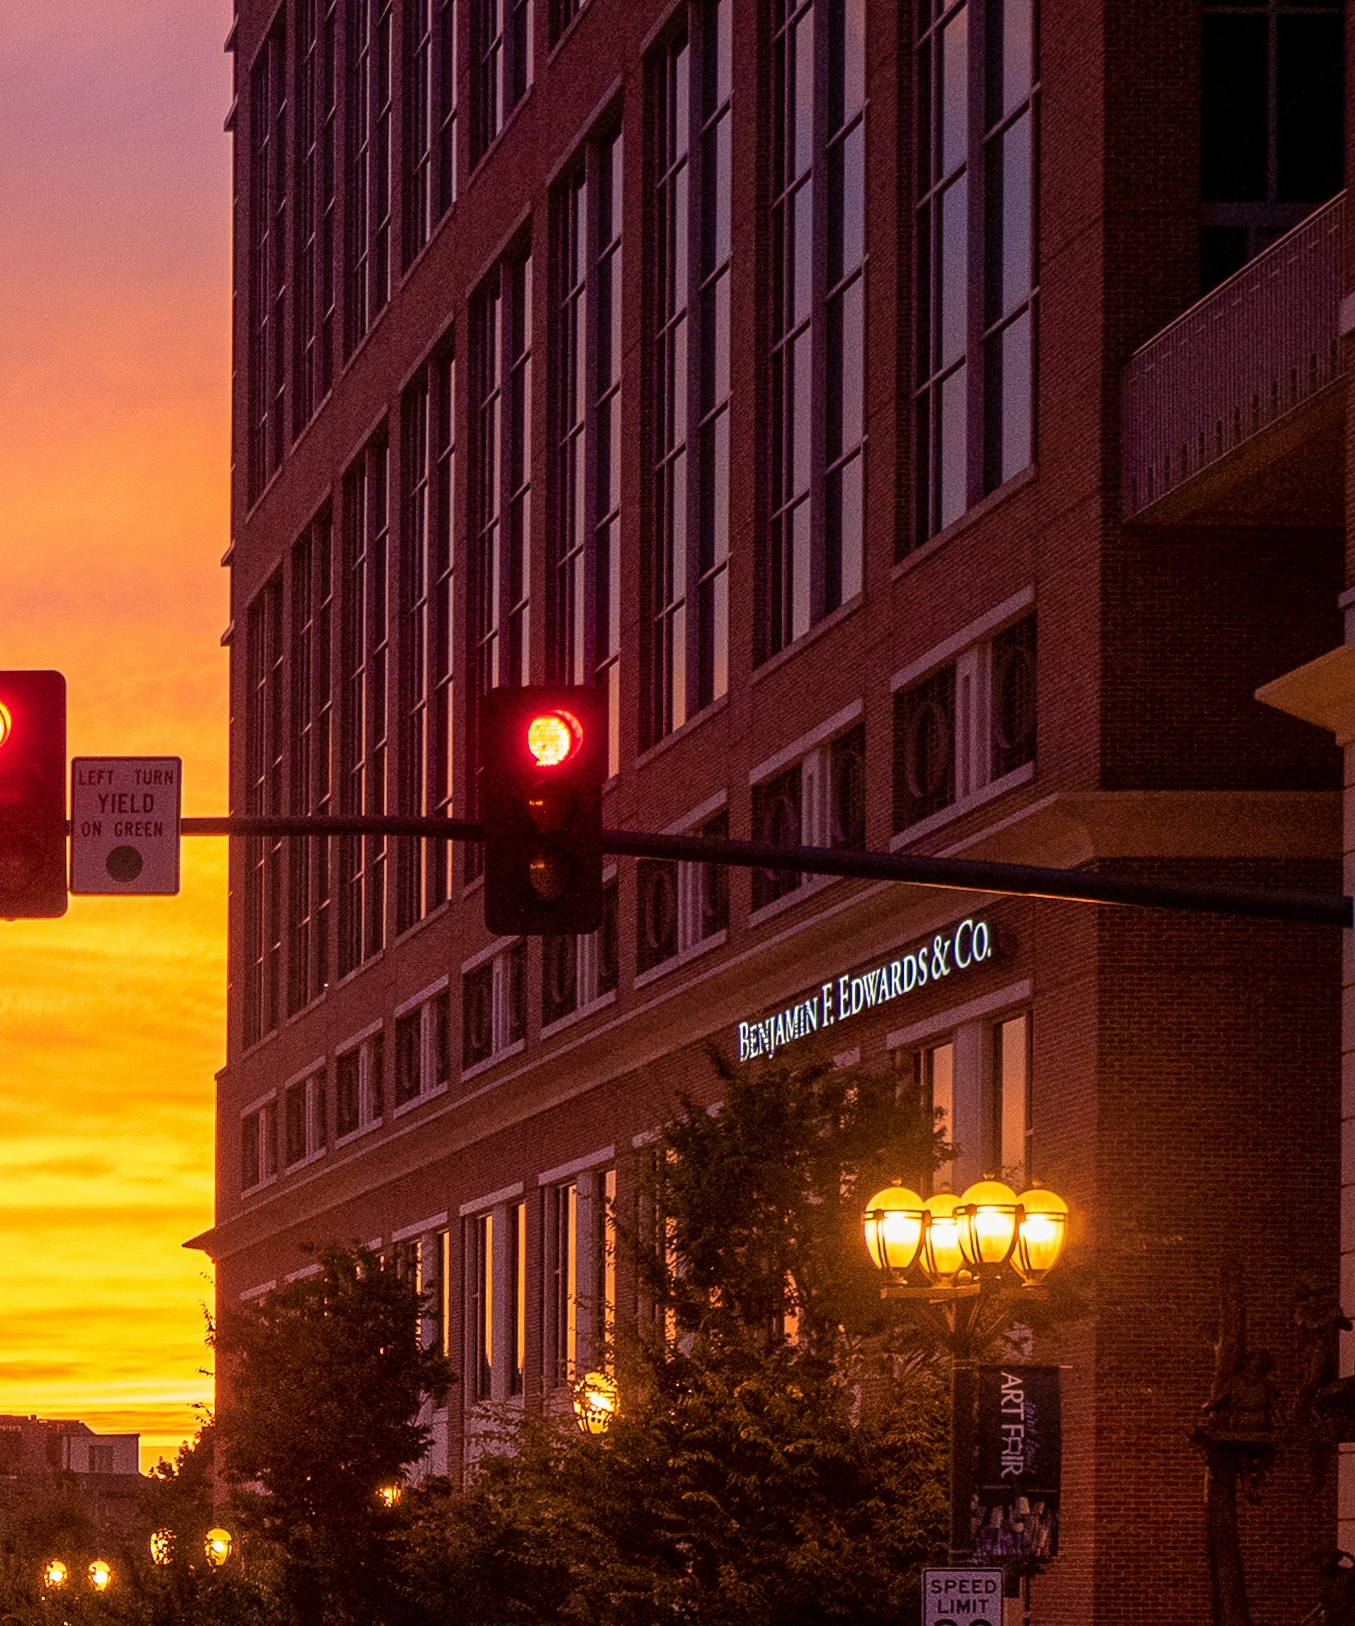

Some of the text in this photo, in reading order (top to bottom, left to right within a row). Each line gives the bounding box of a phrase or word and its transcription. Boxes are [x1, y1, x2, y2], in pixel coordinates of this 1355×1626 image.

[78, 770, 173, 786] LEFT TURN
[98, 793, 154, 814] YIELD
[81, 822, 163, 837] ON GREEN
[738, 919, 992, 1062] BENJAMIN F. EDWARDS & CO.
[1000, 1371, 1025, 1478] ART FAIR
[930, 1579, 997, 1594] SPEED
[937, 1599, 989, 1614] LIMIT
